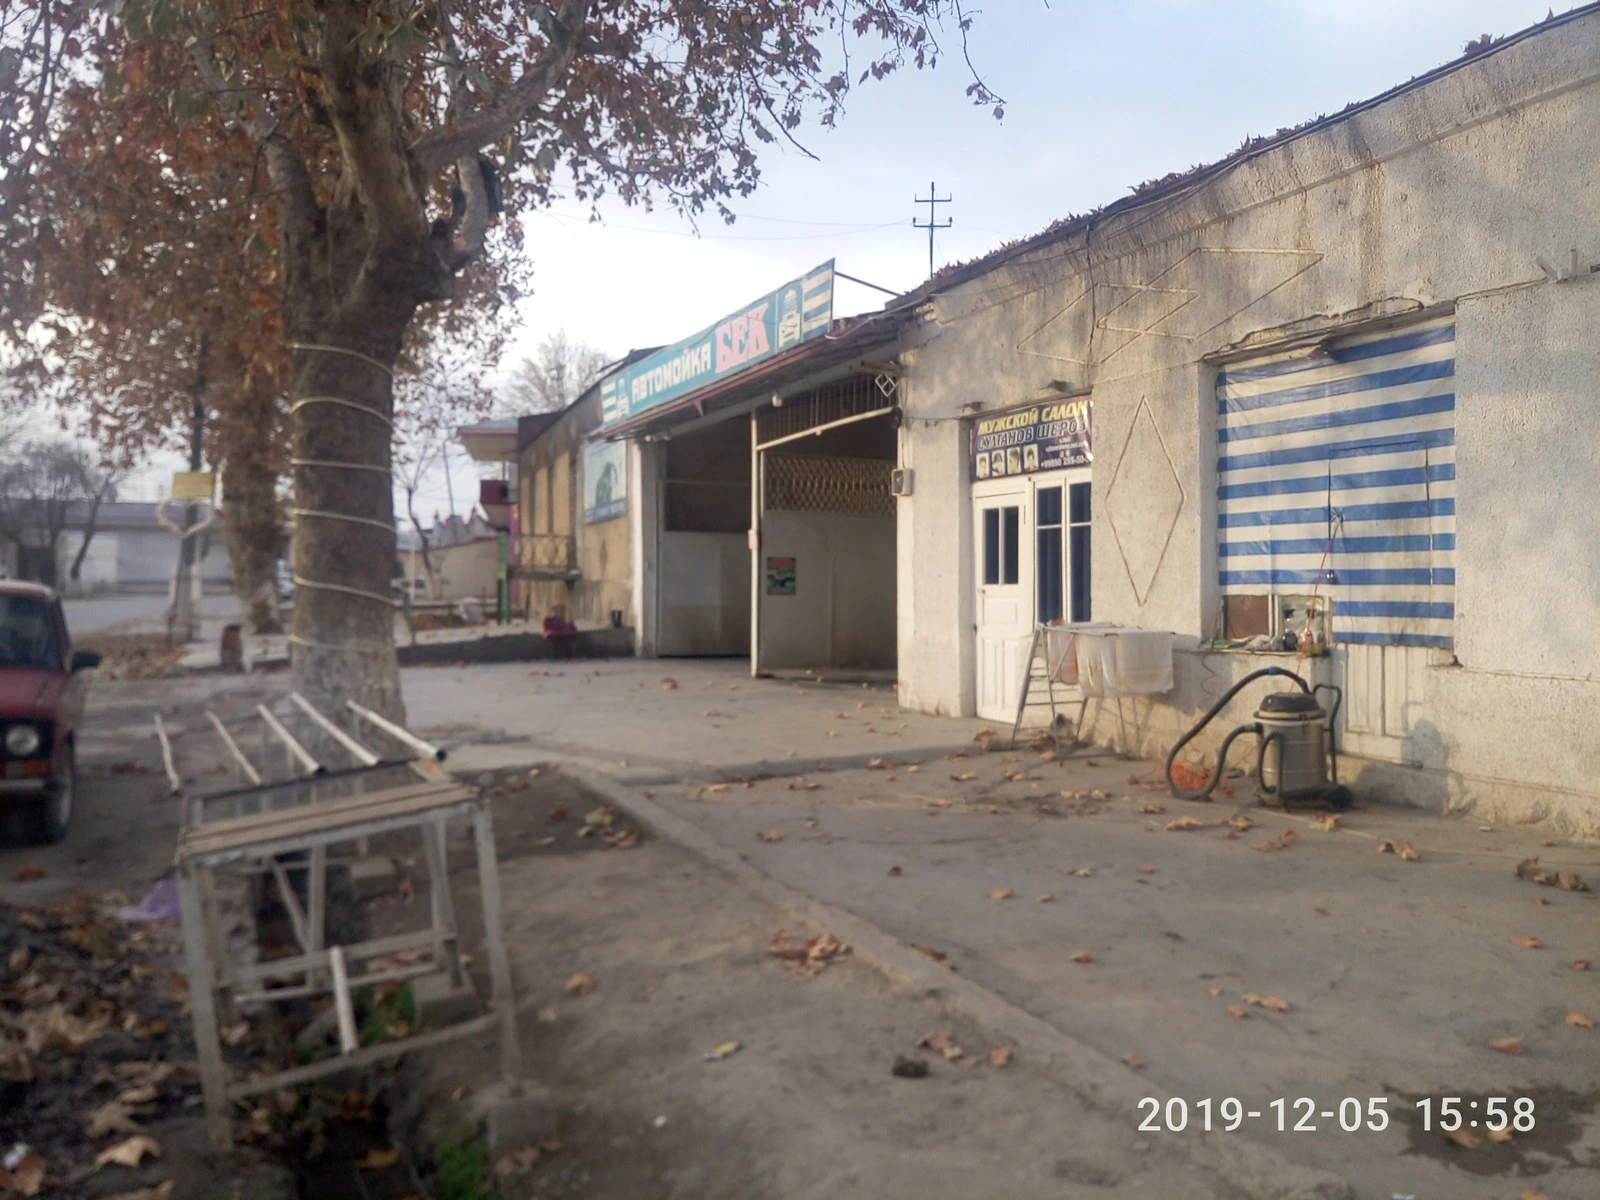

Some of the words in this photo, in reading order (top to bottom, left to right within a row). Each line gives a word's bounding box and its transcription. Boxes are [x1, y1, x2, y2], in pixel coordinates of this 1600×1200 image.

[631, 342, 712, 403] АВТОМОЙКА
[977, 407, 1039, 436] МУЖСКОЙ
[1041, 400, 1088, 423] САЛОН
